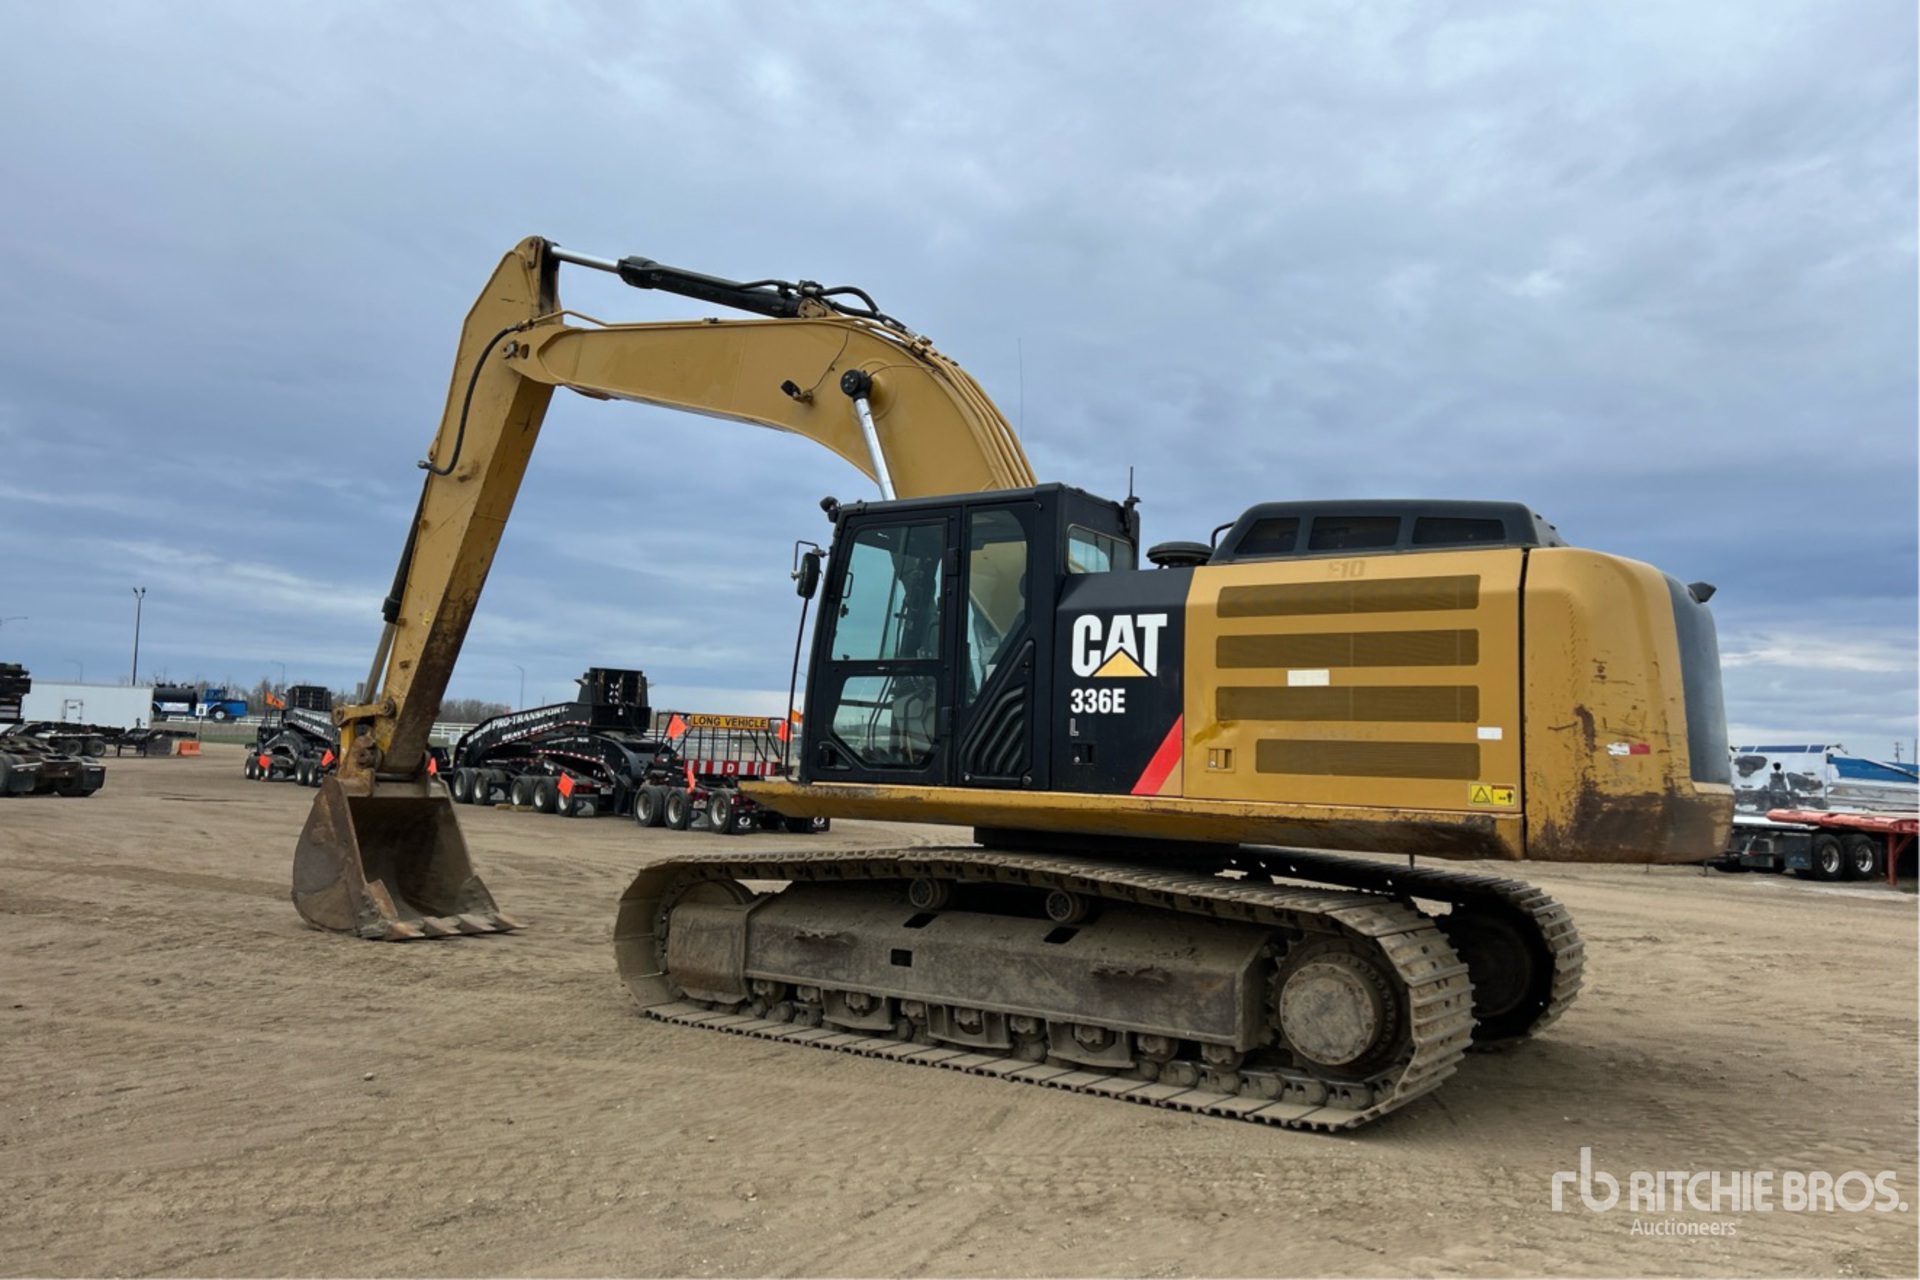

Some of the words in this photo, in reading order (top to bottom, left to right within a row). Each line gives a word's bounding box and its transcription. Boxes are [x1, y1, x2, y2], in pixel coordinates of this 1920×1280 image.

[1071, 613, 1168, 678] CAT
[1070, 688, 1126, 714] 336E
[693, 716, 721, 726] LONG
[725, 717, 766, 728] VEHICLE
[1069, 718, 1080, 737] L
[726, 762, 735, 773] D
